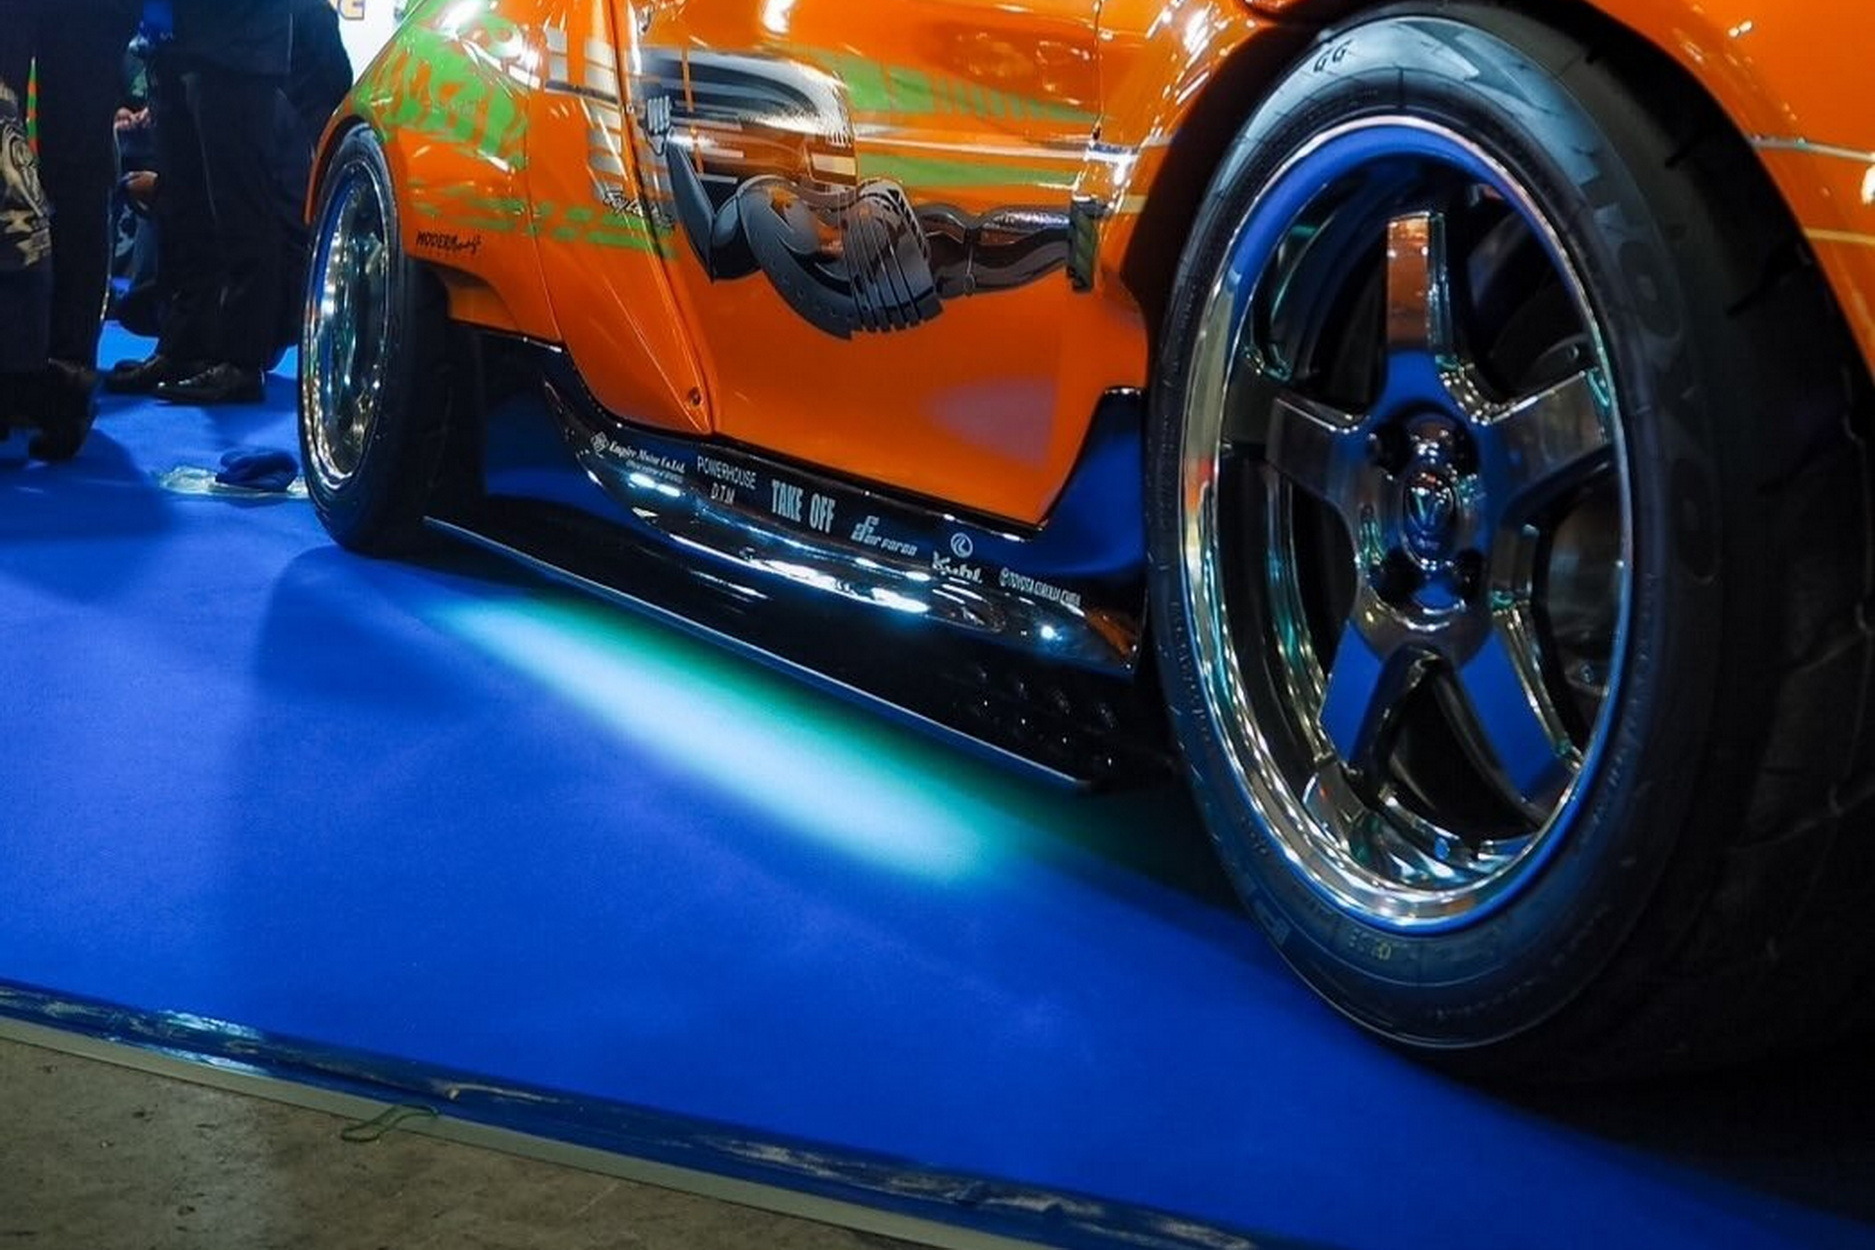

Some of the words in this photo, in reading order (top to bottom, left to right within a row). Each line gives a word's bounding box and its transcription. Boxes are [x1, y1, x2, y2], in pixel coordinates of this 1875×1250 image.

[696, 456, 757, 490] POWERHOUSE
[771, 478, 803, 524] TAKE
[808, 492, 836, 534] OFF
